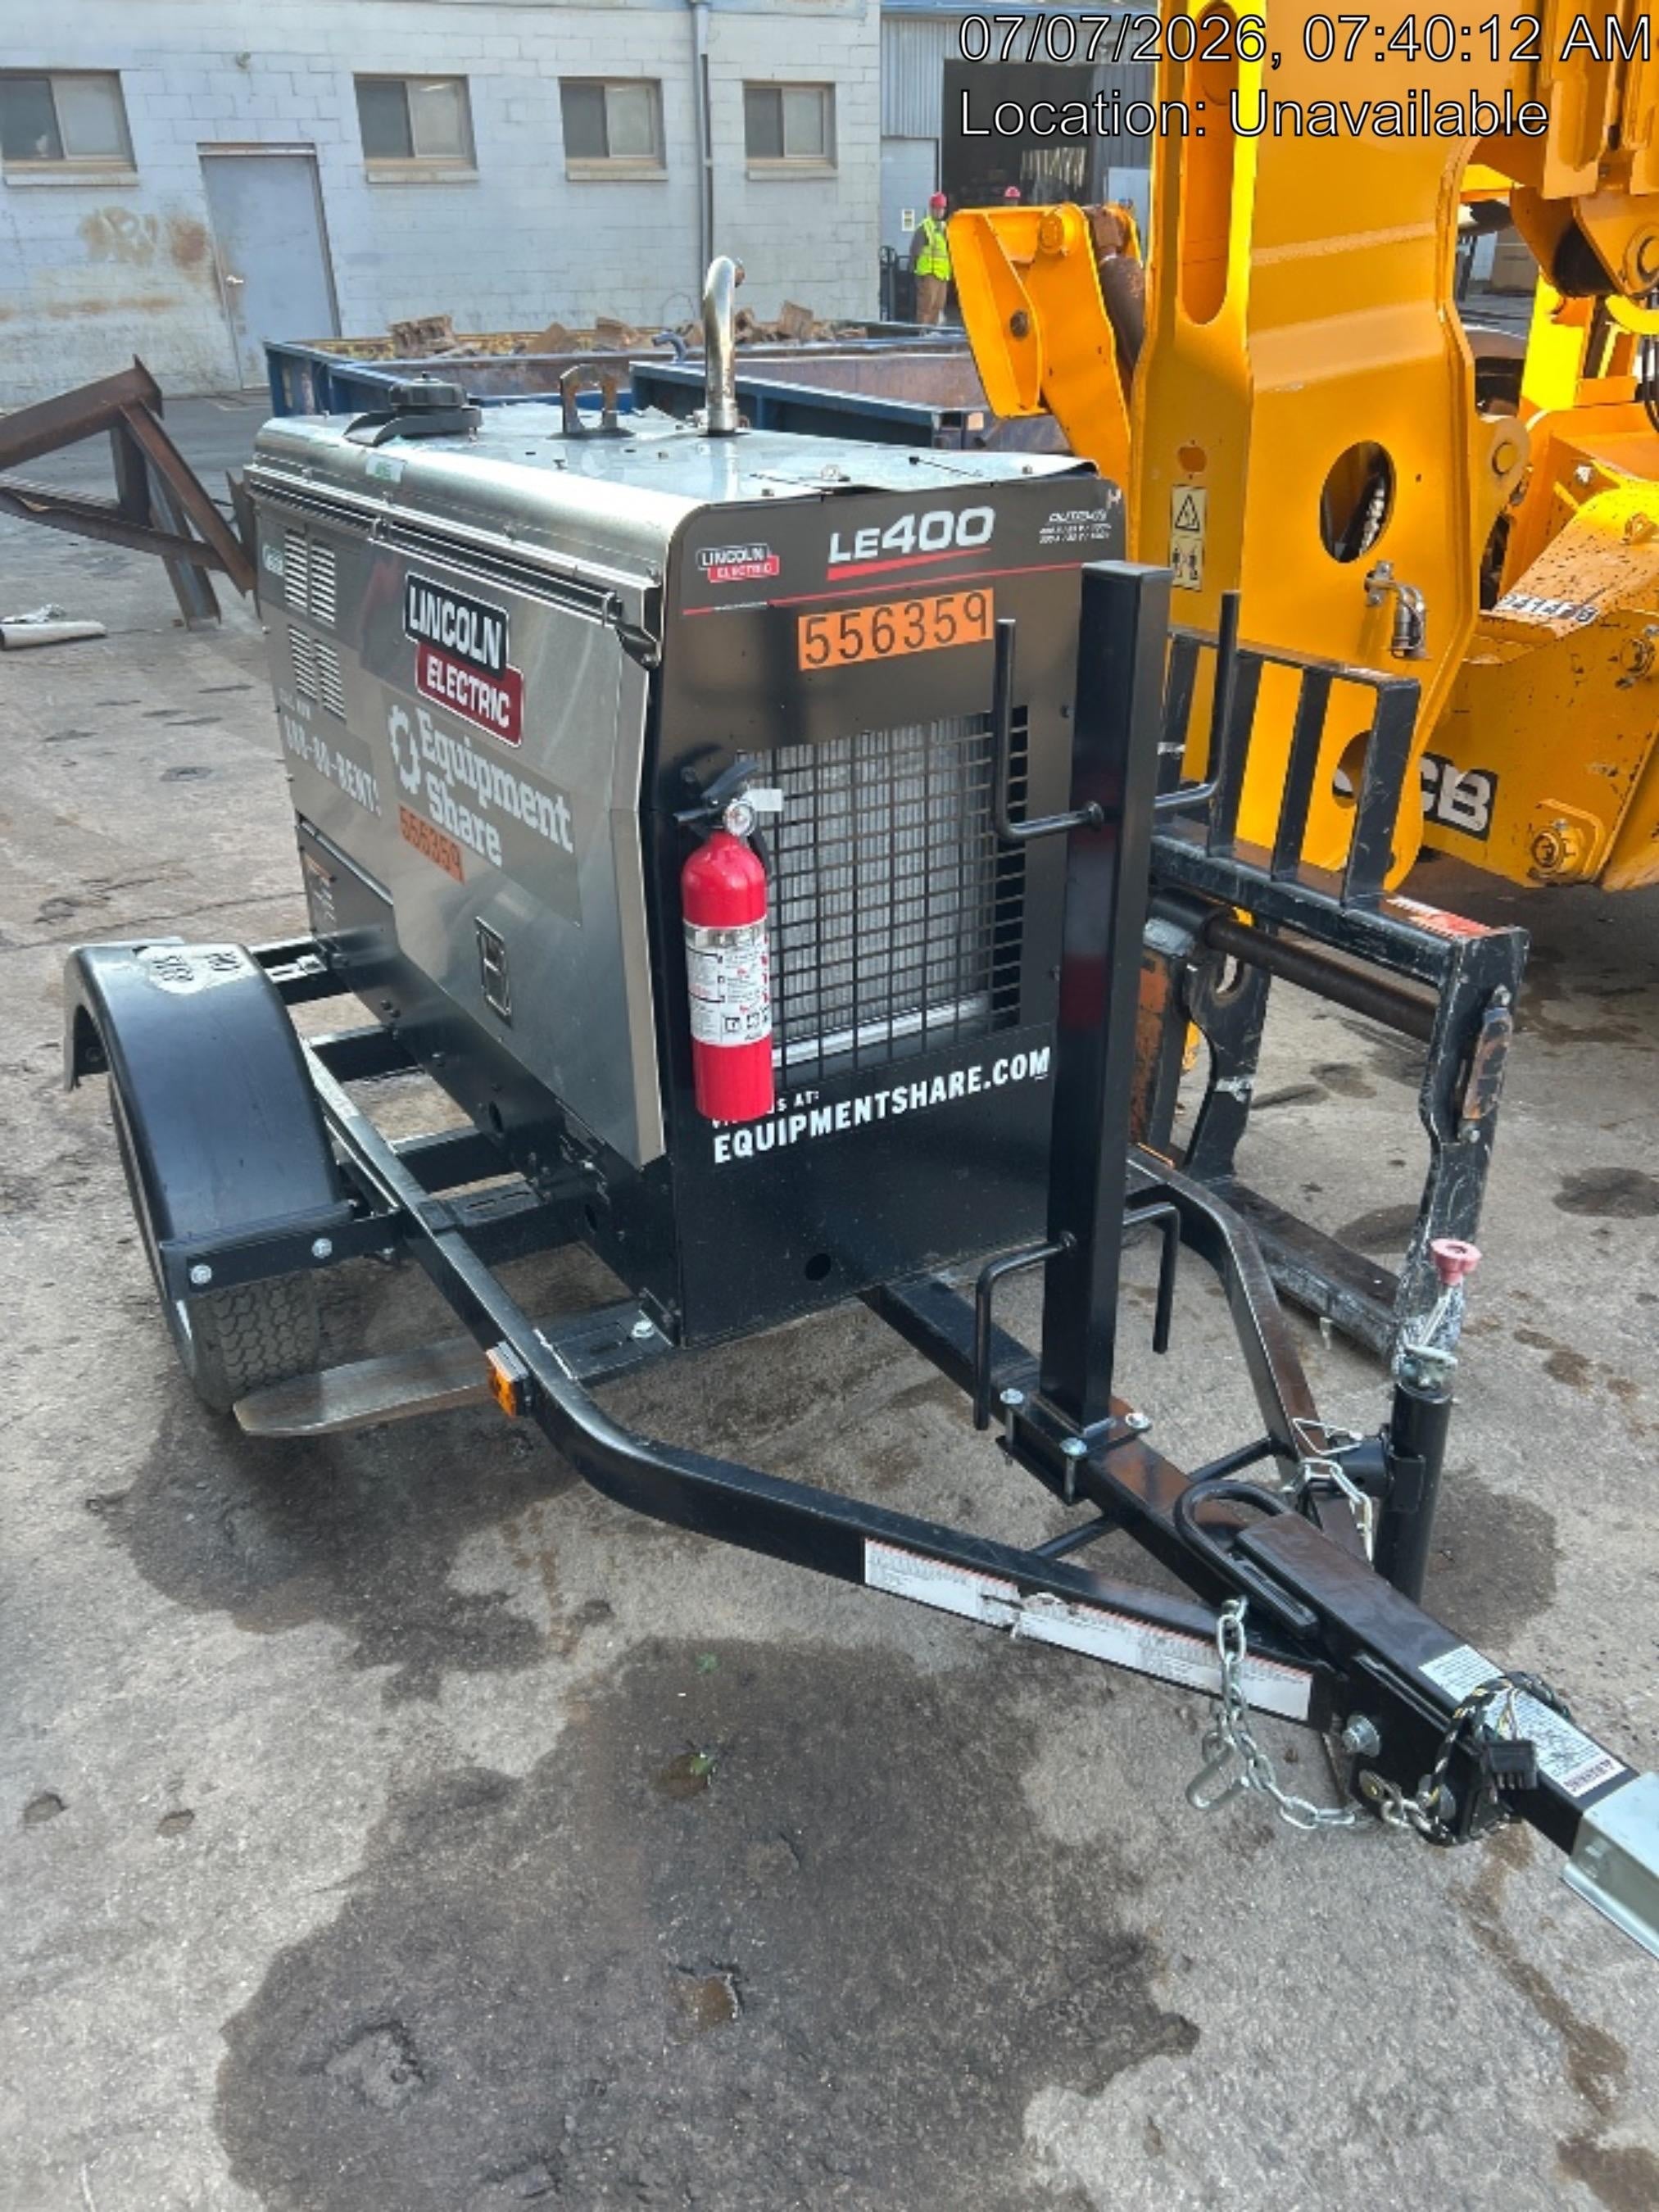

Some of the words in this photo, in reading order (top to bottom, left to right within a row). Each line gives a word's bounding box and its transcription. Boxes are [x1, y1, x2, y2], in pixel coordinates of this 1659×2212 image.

[702, 547, 764, 567] LINCOLN
[828, 506, 995, 564] LE400
[410, 585, 502, 670] LINCOLN
[804, 592, 988, 665] 556359
[426, 653, 510, 728] ELECTRIC
[415, 707, 573, 854] Equipment
[425, 772, 502, 868] Share
[714, 1046, 1051, 1164] EQUIPMENTSHARE.COM
